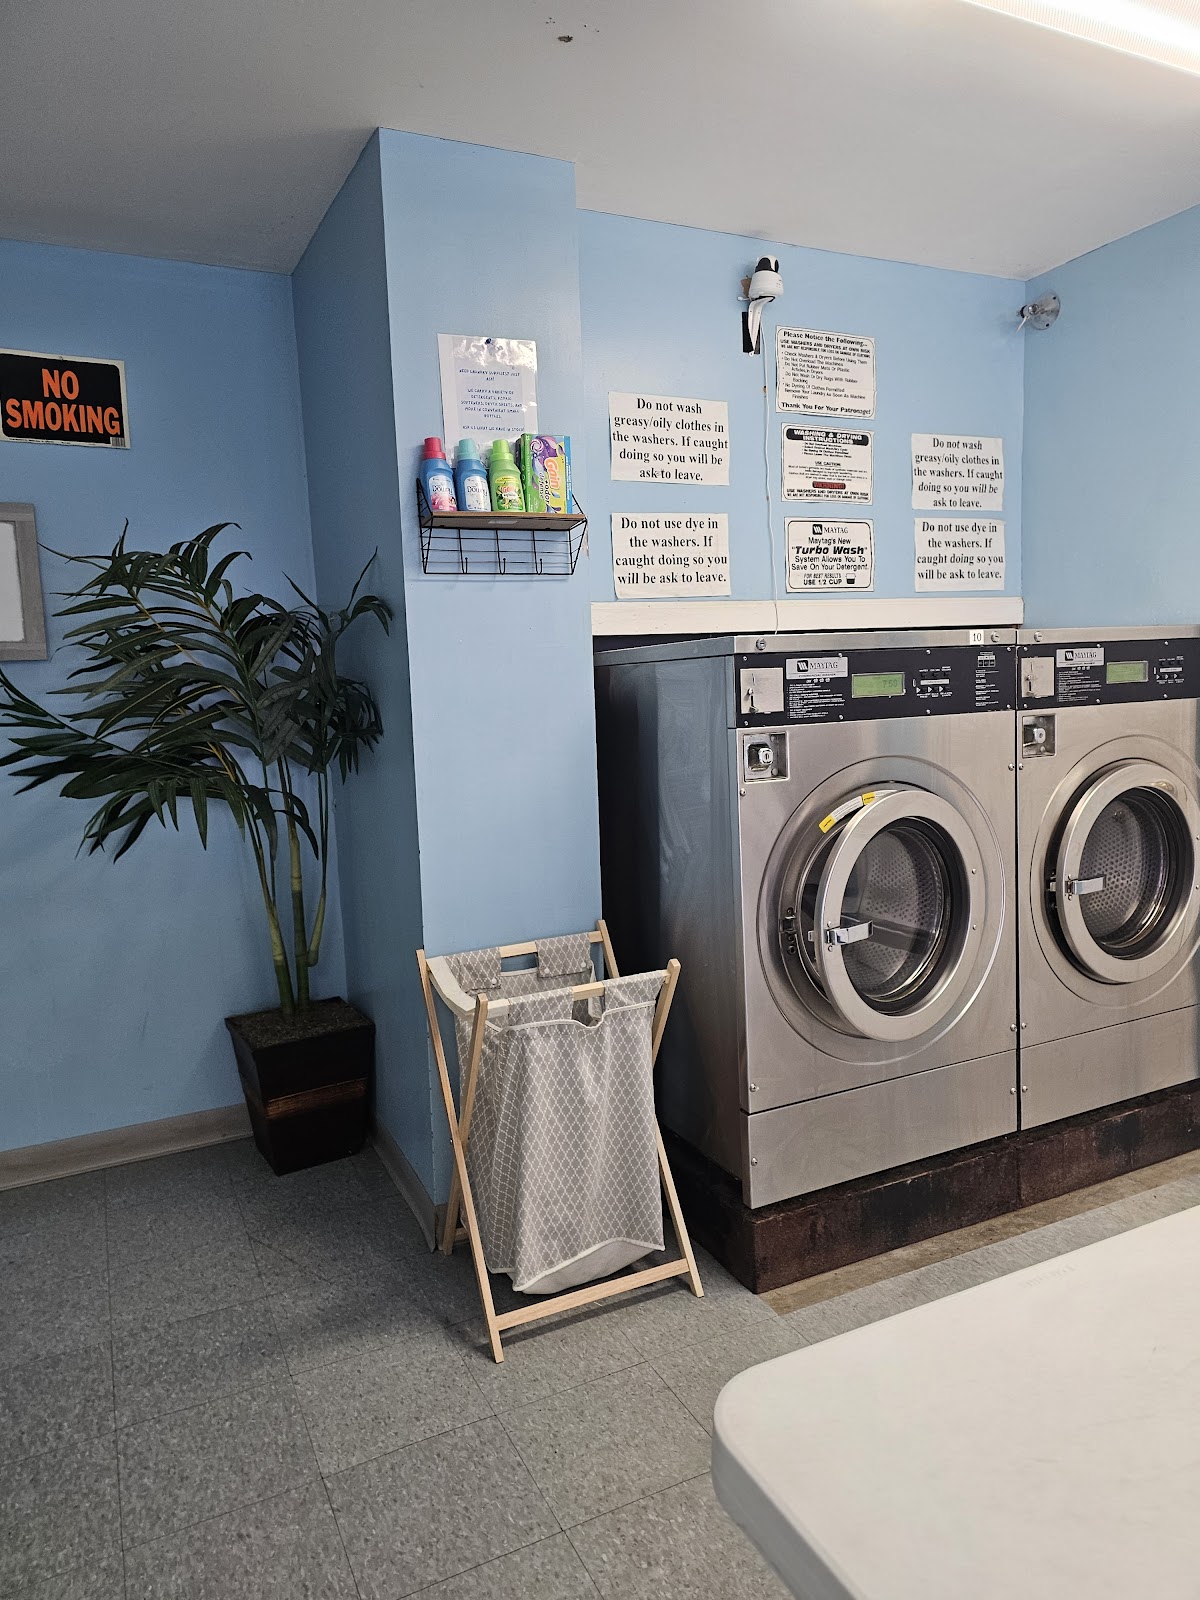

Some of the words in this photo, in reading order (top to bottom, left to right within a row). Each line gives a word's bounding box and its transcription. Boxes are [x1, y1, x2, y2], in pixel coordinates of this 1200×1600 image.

[42, 368, 79, 400] NO
[637, 397, 652, 410] Do
[656, 401, 673, 412] not
[677, 403, 703, 414] wash
[841, 407, 871, 415] Patronage!
[5, 398, 120, 435] SMOKING
[614, 416, 672, 432] greasy/oily
[675, 419, 711, 431] clothes
[714, 421, 724, 433] in
[613, 431, 629, 442] the
[632, 434, 678, 446] washers.
[681, 436, 691, 446] If
[694, 439, 728, 451] caught
[803, 436, 853, 444] INSTRUCTIONS
[933, 438, 944, 448] Do
[947, 440, 960, 449] not
[962, 441, 982, 450] wash
[620, 448, 650, 463] doing
[653, 453, 664, 461] so
[667, 454, 685, 464] you
[689, 454, 708, 464] will
[711, 454, 723, 465] be
[915, 454, 959, 465] greasy/oily
[962, 455, 989, 465] clothes
[991, 456, 999, 465] in
[544, 458, 559, 489] Gain
[640, 468, 658, 478] ask
[661, 469, 671, 479] to
[674, 469, 703, 481] leave.
[914, 467, 927, 476] the
[929, 468, 964, 478] washers.
[967, 469, 974, 478] If
[976, 471, 1003, 481] caught
[918, 482, 941, 494] doing
[954, 486, 969, 494] you
[972, 484, 987, 493] will
[989, 484, 998, 493] be
[933, 498, 947, 507] ask
[949, 499, 957, 507] to
[960, 498, 982, 508] leave.
[621, 517, 637, 529] Do
[641, 518, 660, 529] not
[664, 520, 682, 529] use
[685, 517, 705, 532] dye
[708, 518, 718, 529] in
[922, 522, 935, 532] Do
[938, 523, 952, 532] not
[955, 524, 969, 532] use
[972, 522, 987, 535] dye
[989, 522, 997, 532] in
[630, 536, 648, 547] the
[652, 536, 700, 547] washers.
[703, 536, 713, 547] If
[808, 537, 836, 545] Maytag's
[928, 538, 942, 548] the
[945, 538, 982, 548] washers.
[985, 538, 992, 548] If
[792, 546, 829, 554] "Turbo
[833, 546, 867, 554] Wash"
[615, 554, 655, 569] caught
[658, 554, 690, 568] doing
[693, 556, 704, 564] so
[707, 556, 727, 567] you
[795, 556, 819, 564] System
[917, 554, 947, 566] caught
[950, 554, 974, 566] doing
[988, 556, 1003, 565] you
[618, 573, 639, 584] will
[643, 573, 656, 584] be
[659, 572, 678, 583] ask
[682, 573, 692, 582] to
[696, 572, 726, 582] leave.
[918, 570, 934, 579] will
[937, 569, 947, 579] be
[950, 569, 964, 578] ask
[978, 569, 1001, 578] leave.
[973, 633, 981, 641] 10
[1074, 651, 1096, 659] MAYTAG
